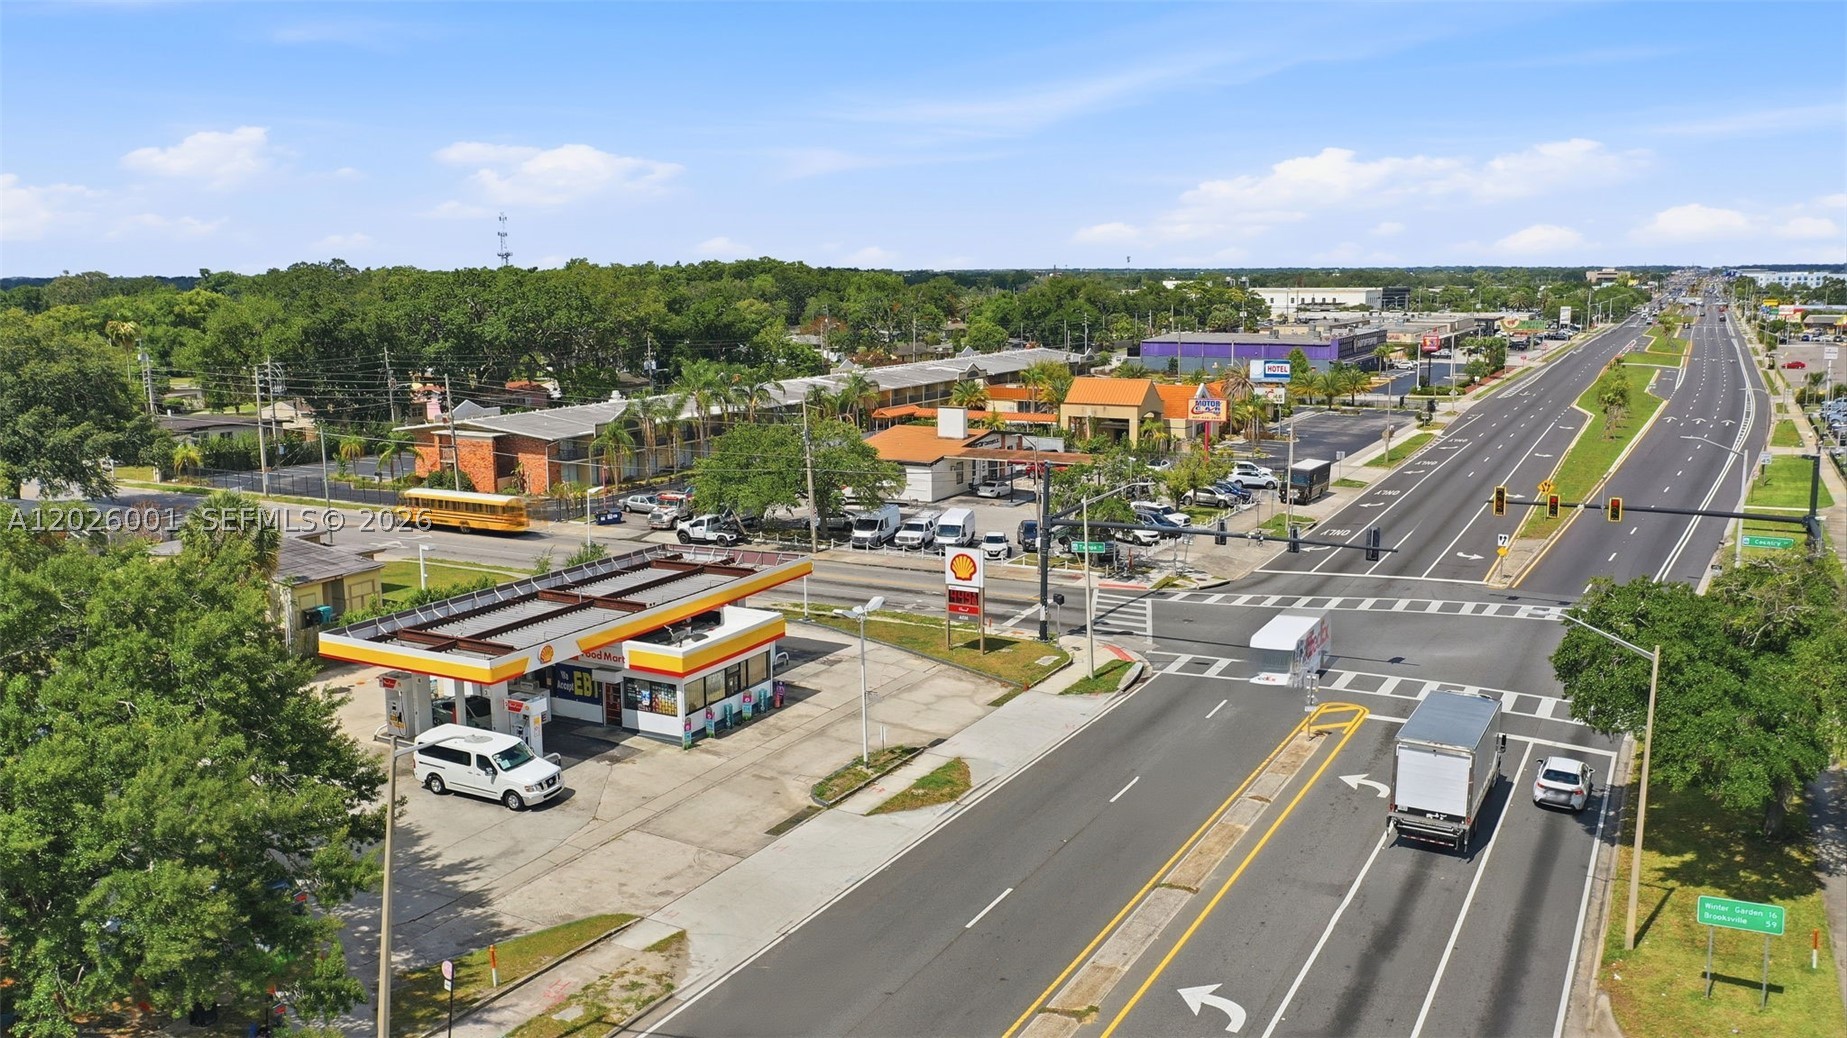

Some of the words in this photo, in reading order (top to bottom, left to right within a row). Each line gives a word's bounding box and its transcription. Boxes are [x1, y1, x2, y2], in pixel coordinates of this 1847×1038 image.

[1267, 365, 1288, 373] HOTEL
[581, 651, 602, 660] ood
[603, 652, 625, 663] Mart
[557, 681, 574, 693] Accept
[1704, 902, 1729, 911] Winter
[1734, 906, 1764, 917] Garden
[1768, 911, 1778, 919] 16
[1703, 911, 1748, 924] Brooksville
[1765, 920, 1777, 928] 59
